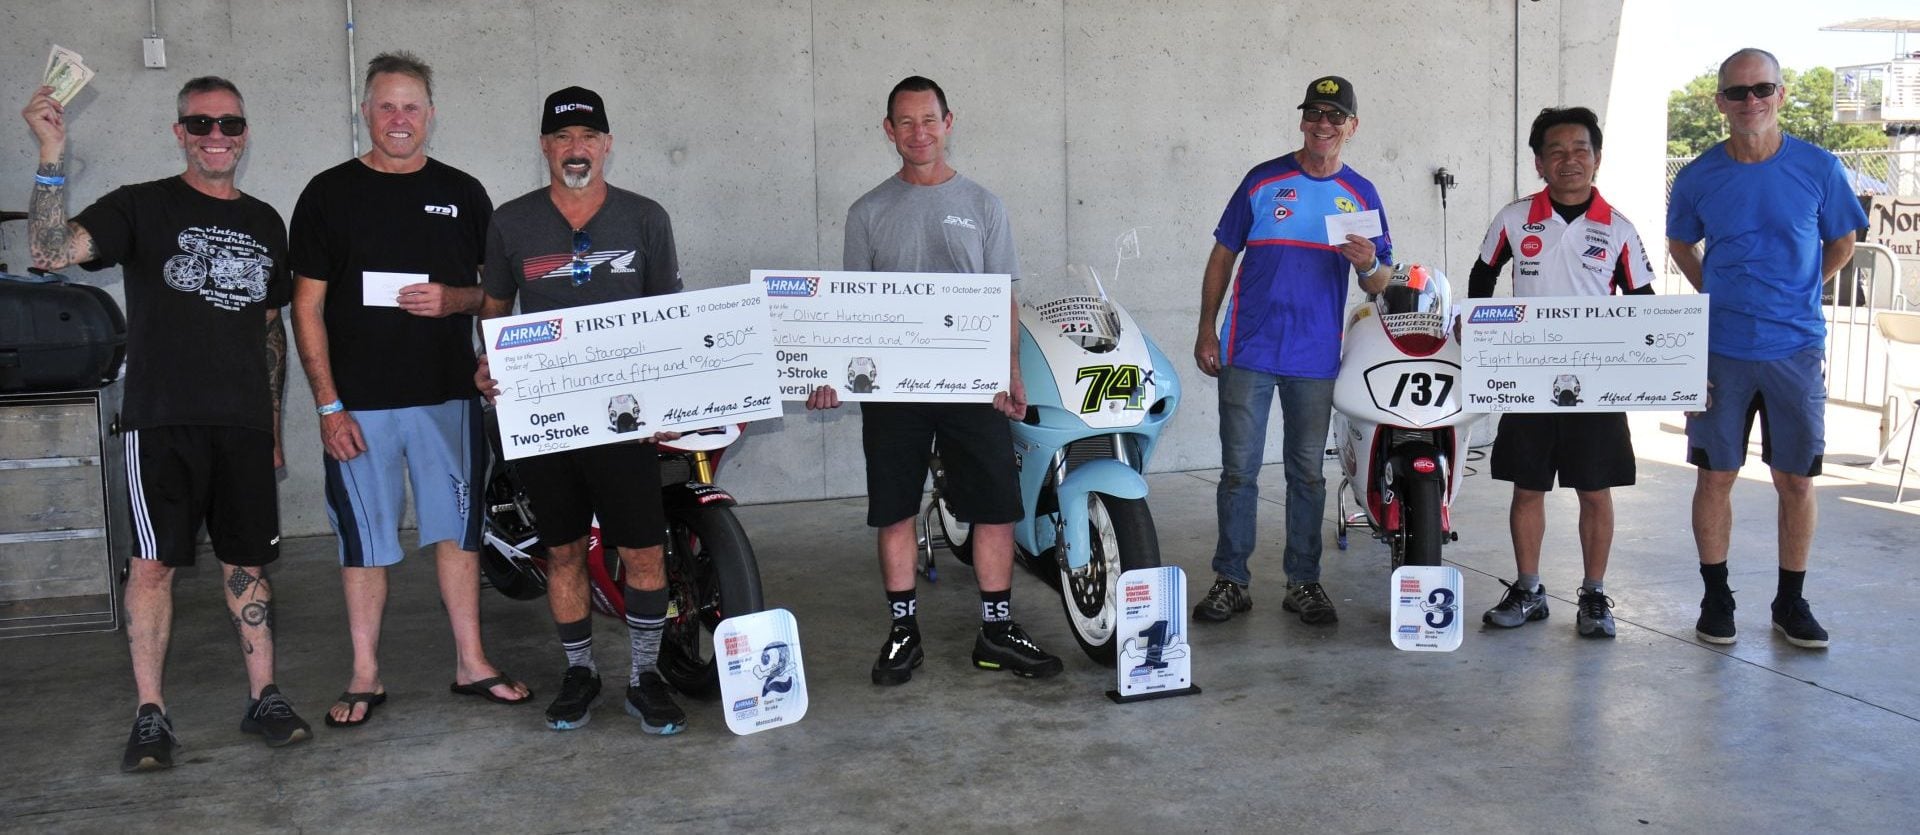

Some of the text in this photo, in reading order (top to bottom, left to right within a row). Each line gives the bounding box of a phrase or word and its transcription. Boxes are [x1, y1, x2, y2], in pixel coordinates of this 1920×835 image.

[206, 226, 252, 240] vintage
[830, 281, 877, 294] FIRST
[882, 283, 935, 295] PLACE
[952, 286, 981, 294] October
[983, 287, 1001, 295] 2026
[1033, 296, 1101, 311] RIDGESTONE
[575, 313, 626, 333] FIRST
[632, 305, 690, 325] PLACE
[708, 301, 739, 312] October
[742, 297, 761, 307] 2026
[793, 309, 905, 323] Oliver Hutchinson
[1473, 308, 1514, 319] AHRMA
[1536, 307, 1580, 319] FIRST
[1585, 307, 1637, 318] PLACE
[1654, 307, 1681, 315] October
[1684, 307, 1702, 315] 2026
[501, 325, 550, 342] AHRMA
[772, 329, 807, 344] welve
[813, 331, 872, 345] hundred
[878, 335, 904, 345] and
[1502, 328, 1563, 344] Nobi Iso
[535, 341, 645, 369] Ralph Staropoli
[776, 350, 808, 364] Open
[1479, 350, 1511, 373] Eight
[1516, 350, 1568, 366] hundred
[1572, 350, 1602, 372] fifty
[1604, 353, 1628, 363] and
[515, 378, 557, 404] Eight
[562, 369, 626, 387] hundred
[630, 362, 660, 382] fifty
[663, 360, 688, 372] and
[896, 377, 999, 392] Alfred Angas Scott
[1075, 365, 1146, 414] 74
[1487, 379, 1516, 391] Open
[1469, 393, 1535, 404] Two-Stroke
[1598, 391, 1698, 404] Alfred Angas Scott
[663, 396, 772, 422] Alfred Angas Scott
[530, 411, 565, 427] Open
[511, 424, 590, 446] Two-Stroke
[1425, 588, 1455, 629] 3
[1135, 620, 1168, 670] 1
[761, 641, 793, 697] 2
